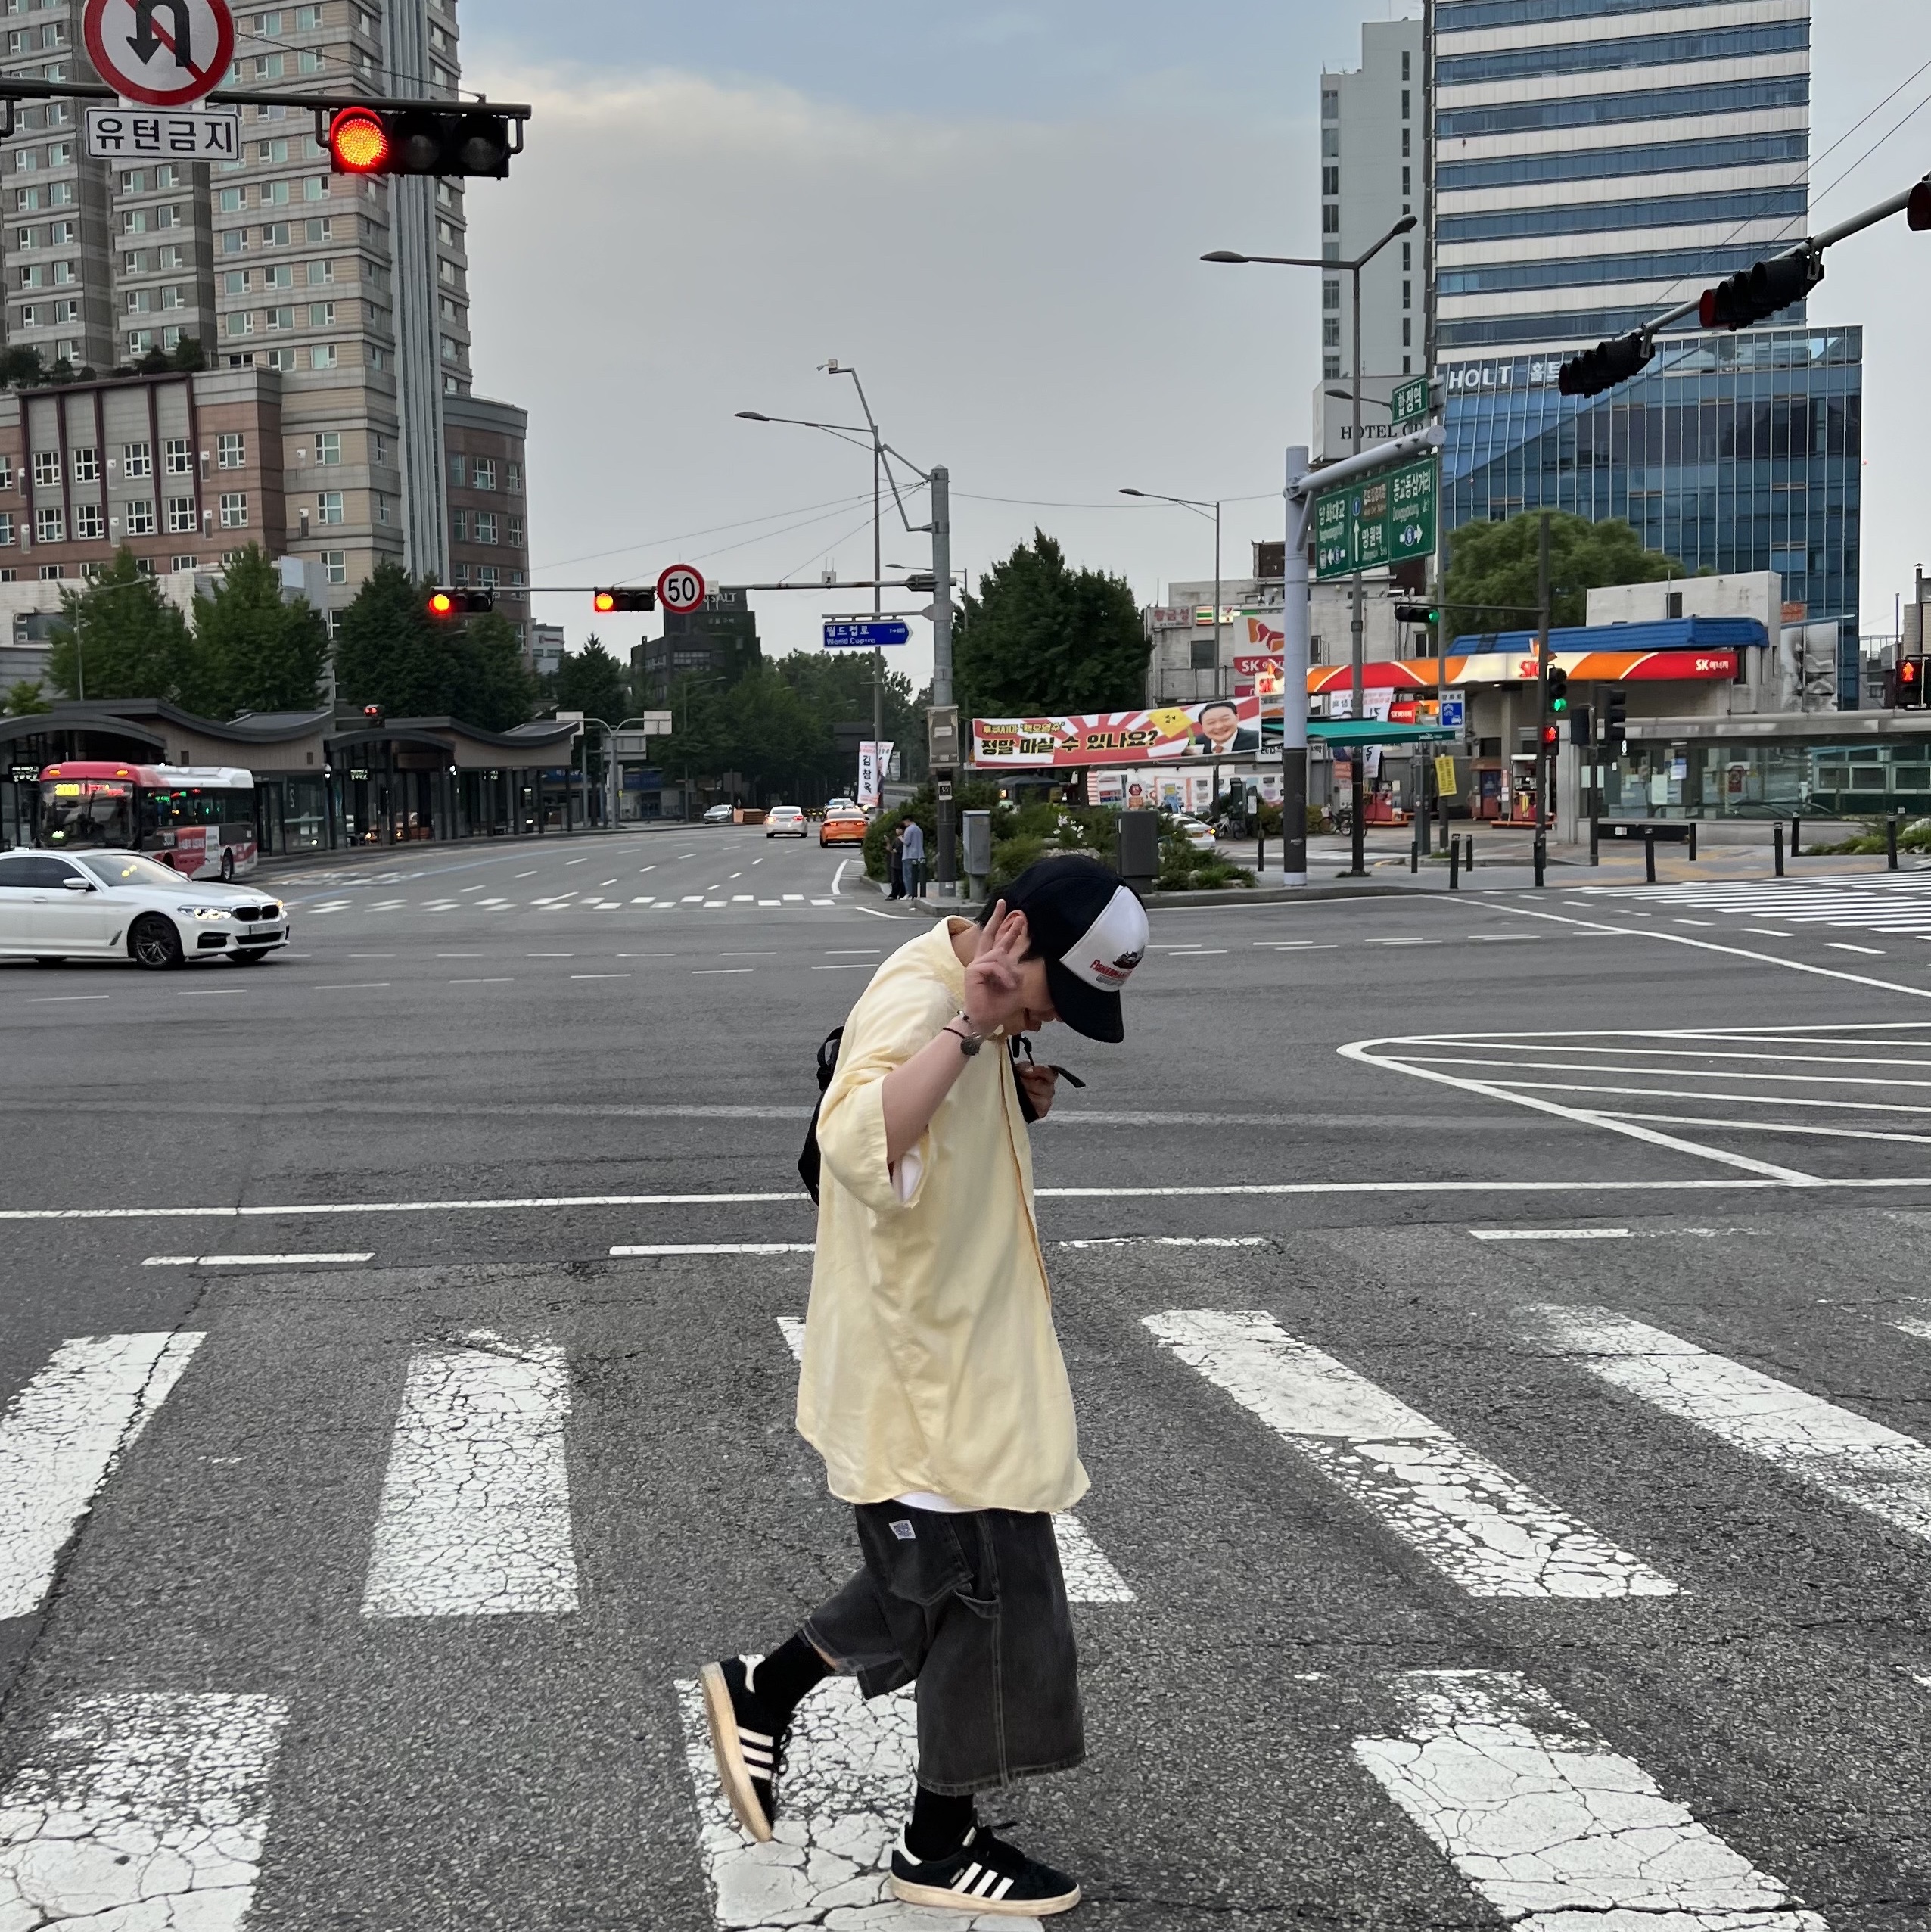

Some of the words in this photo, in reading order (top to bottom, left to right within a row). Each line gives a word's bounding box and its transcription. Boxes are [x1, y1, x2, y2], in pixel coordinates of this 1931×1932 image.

[96, 118, 232, 153] 유턴금지
[1448, 366, 1512, 389] HOLT
[1398, 384, 1422, 416] 합정역
[1393, 468, 1431, 502] 동교동삼거리
[1319, 499, 1345, 526] 양화대교
[1362, 523, 1382, 549] 망원역
[668, 577, 695, 602] 50
[826, 625, 869, 637] 월드컵로
[850, 637, 875, 646] Cup-ro
[1242, 660, 1260, 673] SK
[1695, 658, 1709, 671] SK
[983, 724, 1018, 735] 후쿠시마
[981, 739, 1015, 756] 정말
[1019, 736, 1055, 754] 마실
[1061, 736, 1079, 752] 수
[1086, 730, 1158, 751] 있나요?
